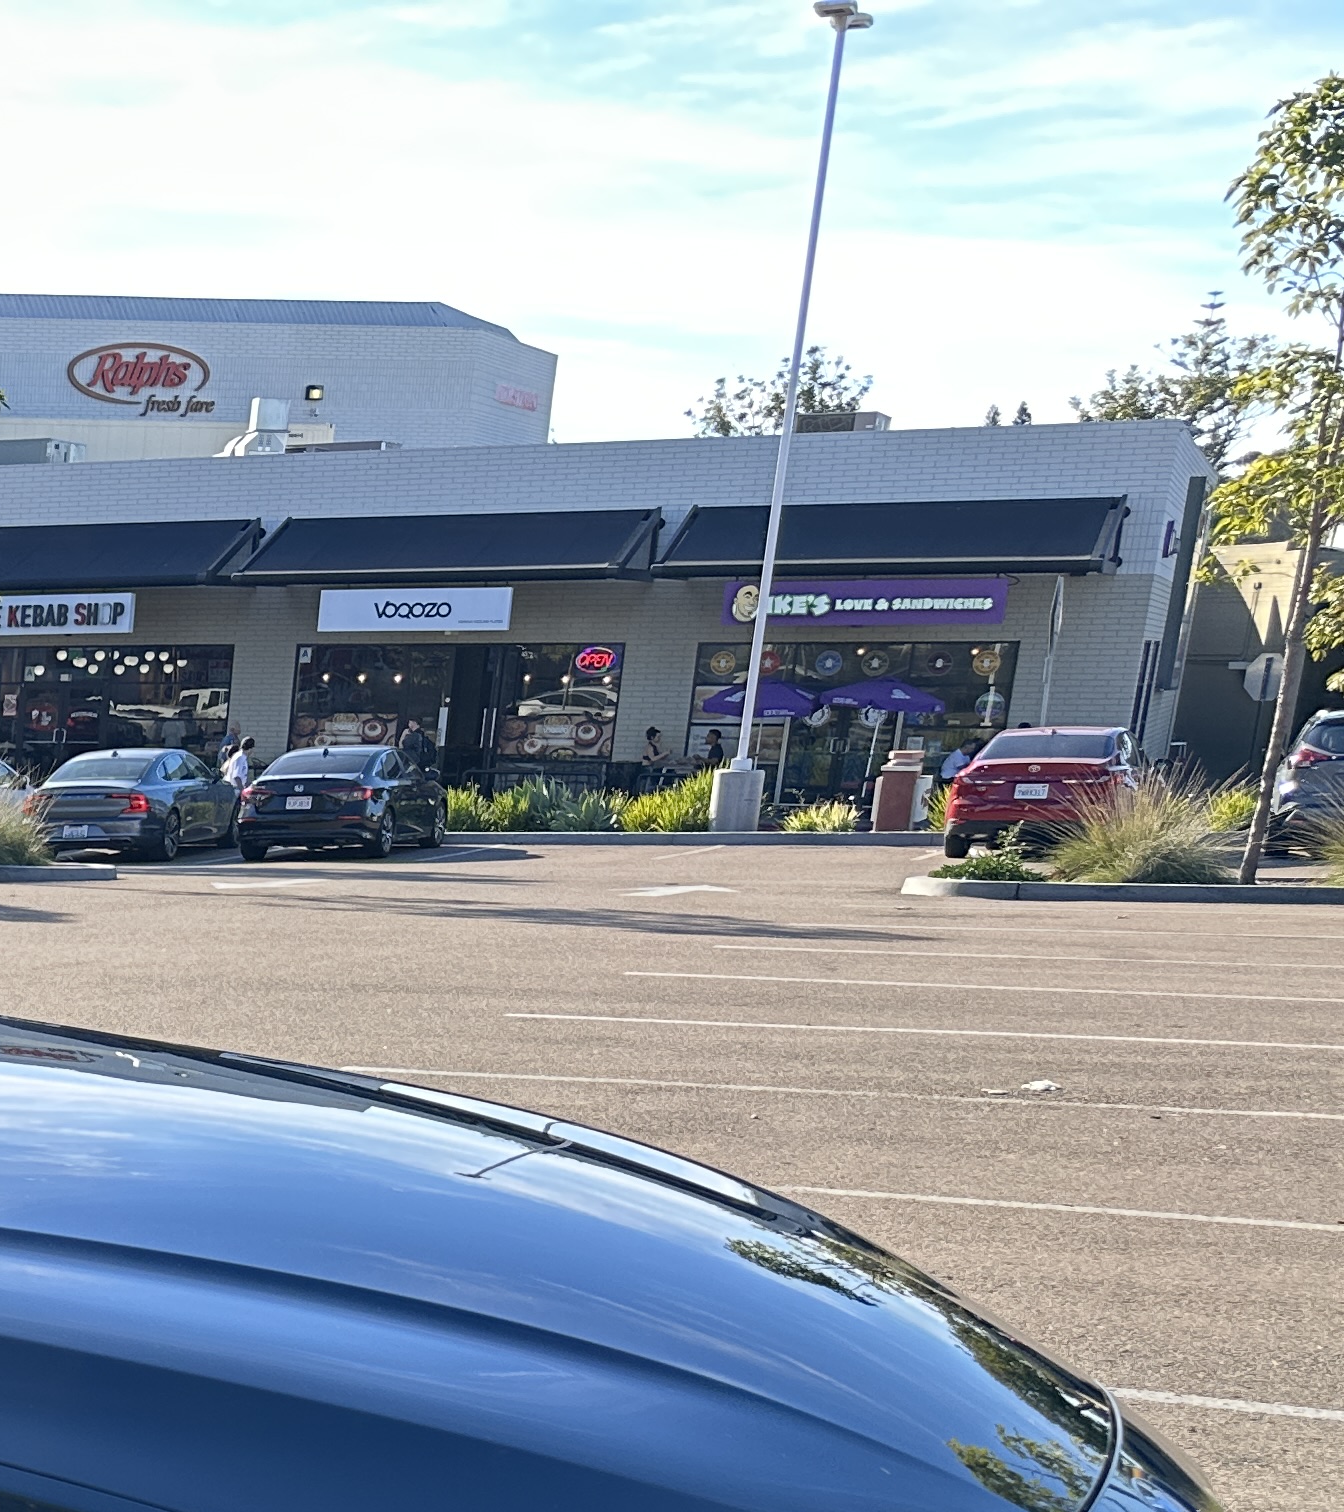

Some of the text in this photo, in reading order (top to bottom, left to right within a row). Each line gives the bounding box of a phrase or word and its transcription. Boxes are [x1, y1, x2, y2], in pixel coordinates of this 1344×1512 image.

[87, 351, 191, 396] Ralphs
[139, 394, 215, 417] fresh fare
[834, 598, 873, 611] LOVE
[874, 598, 889, 611] &
[891, 597, 993, 611] SANDWICHES
[7, 603, 69, 628] KEBAB
[73, 602, 125, 626] SHOP
[301, 649, 309, 658] A
[578, 653, 613, 668] OPEN
